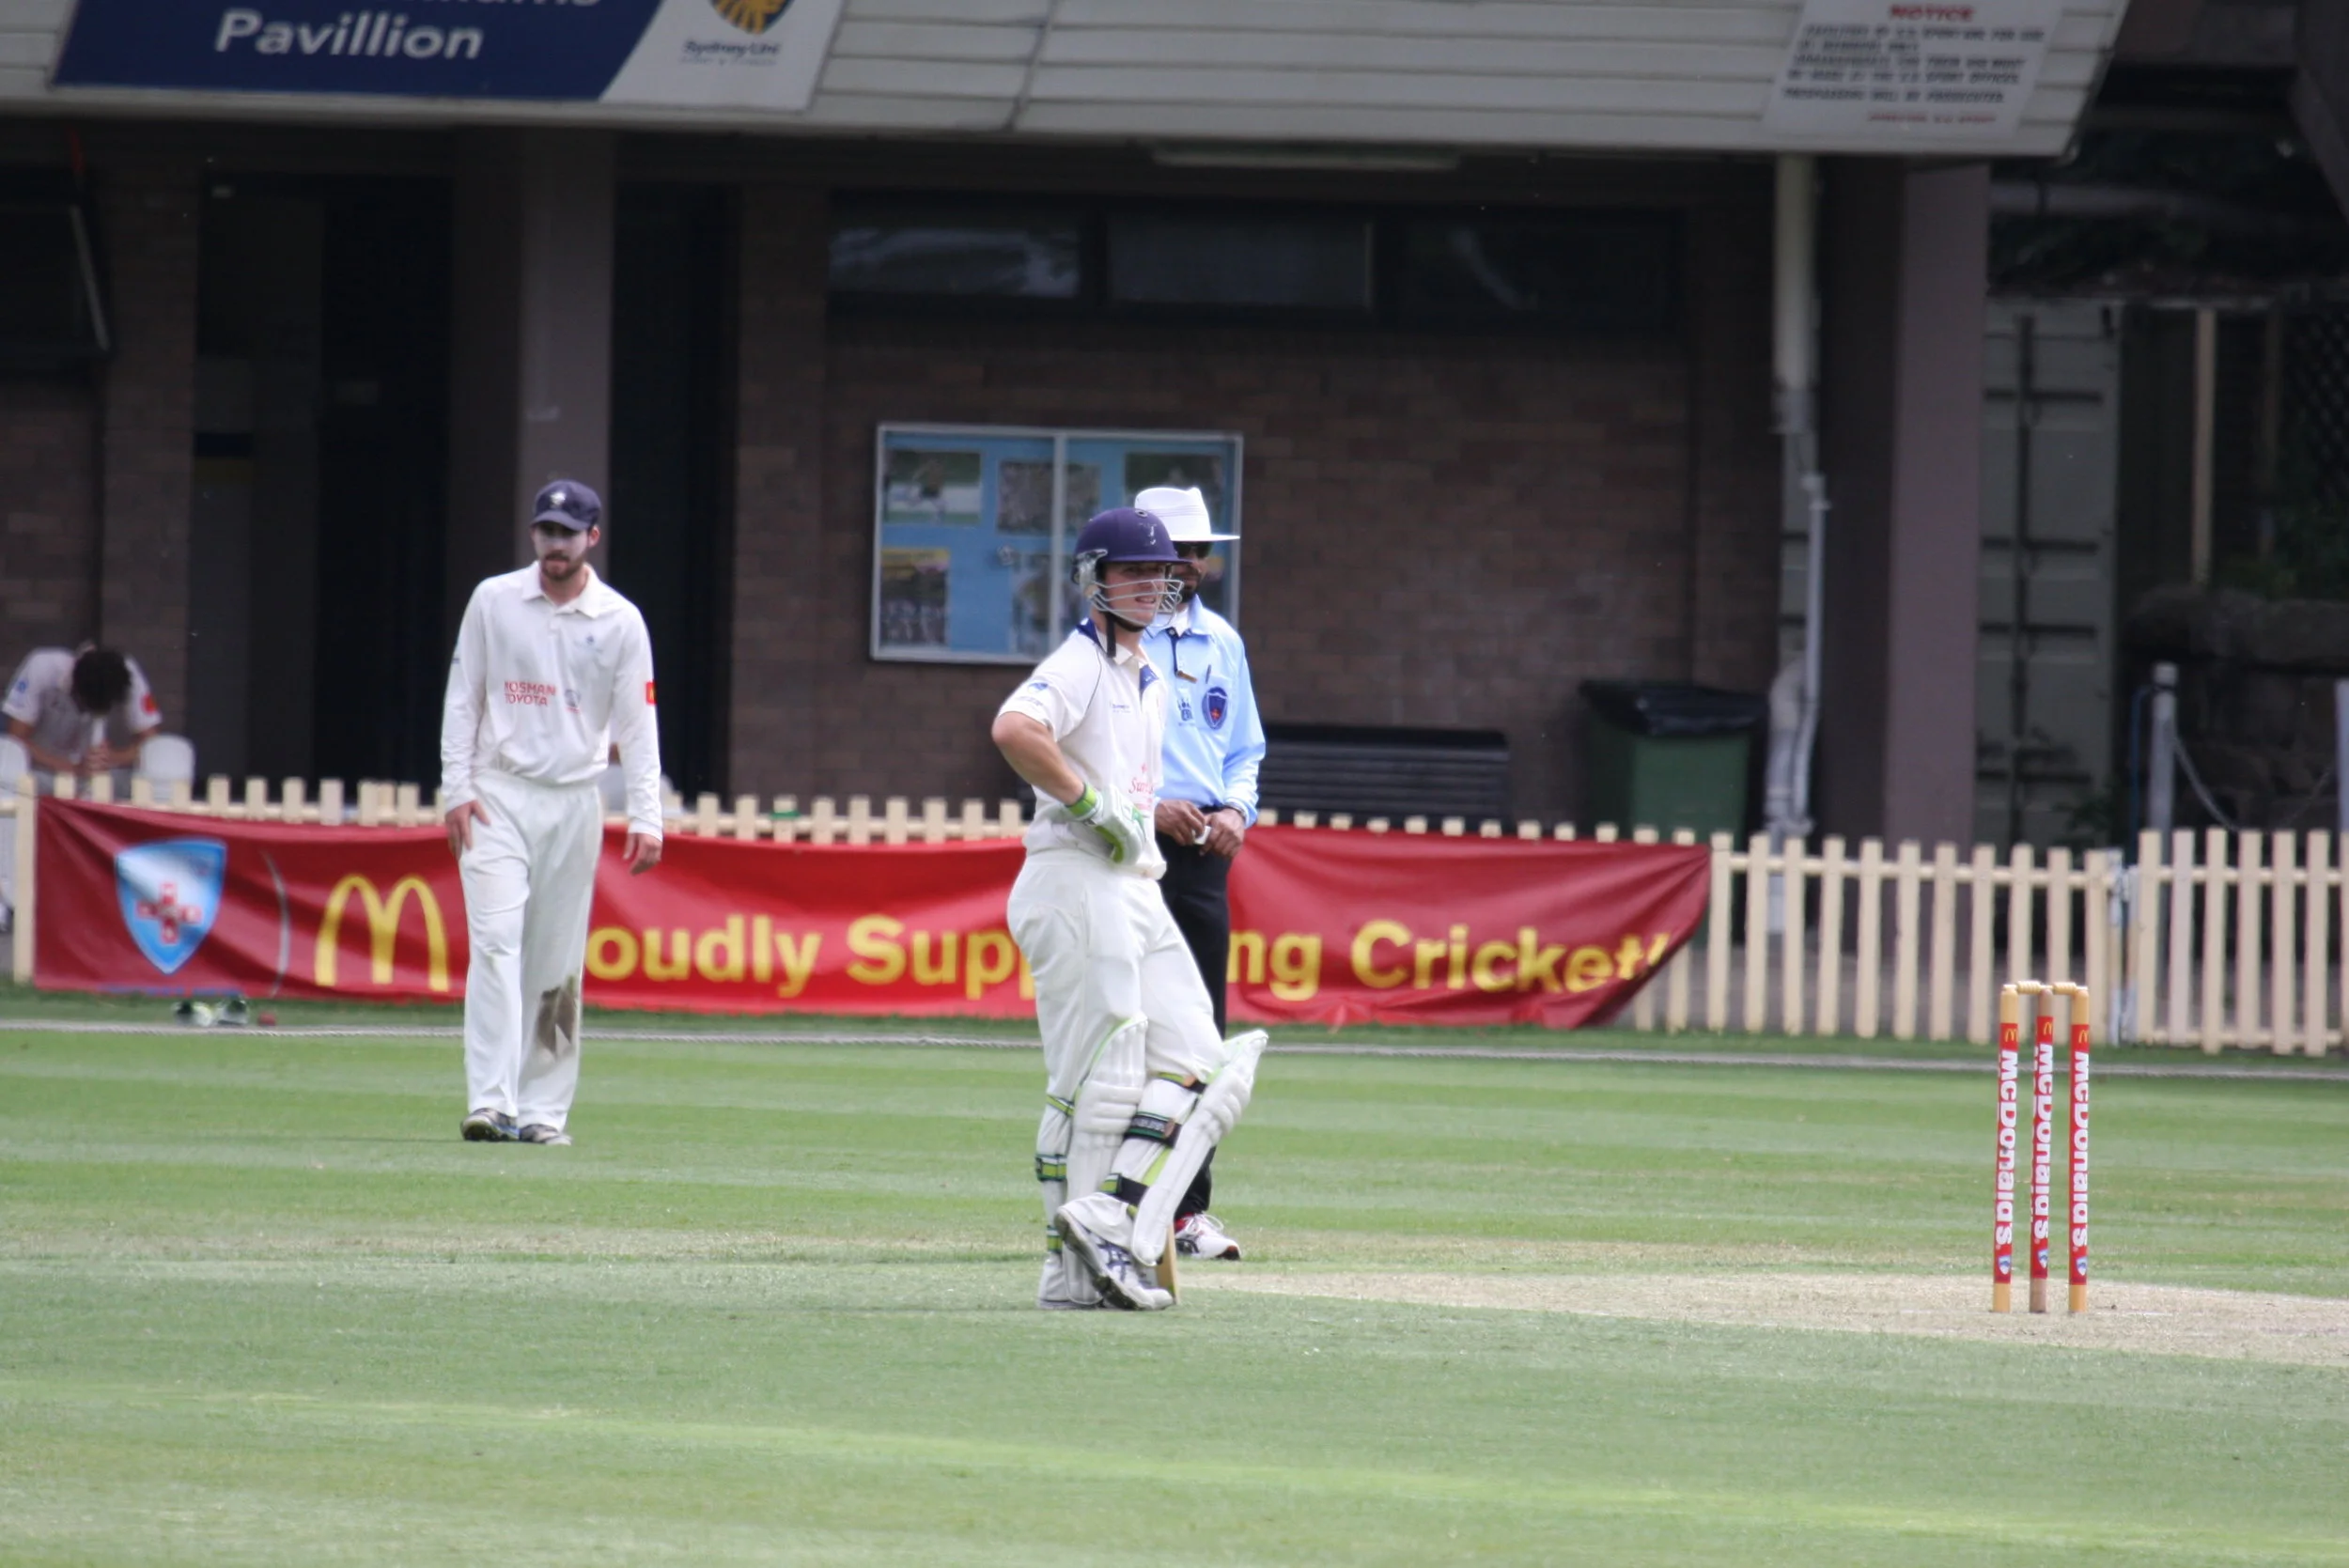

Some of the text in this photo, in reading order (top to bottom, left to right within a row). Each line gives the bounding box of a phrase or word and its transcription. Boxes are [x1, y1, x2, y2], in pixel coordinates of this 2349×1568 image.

[1890, 5, 1974, 21] NOTICE
[215, 11, 484, 59] Pavillion
[683, 39, 747, 57] Sydney
[583, 915, 822, 998] oudly
